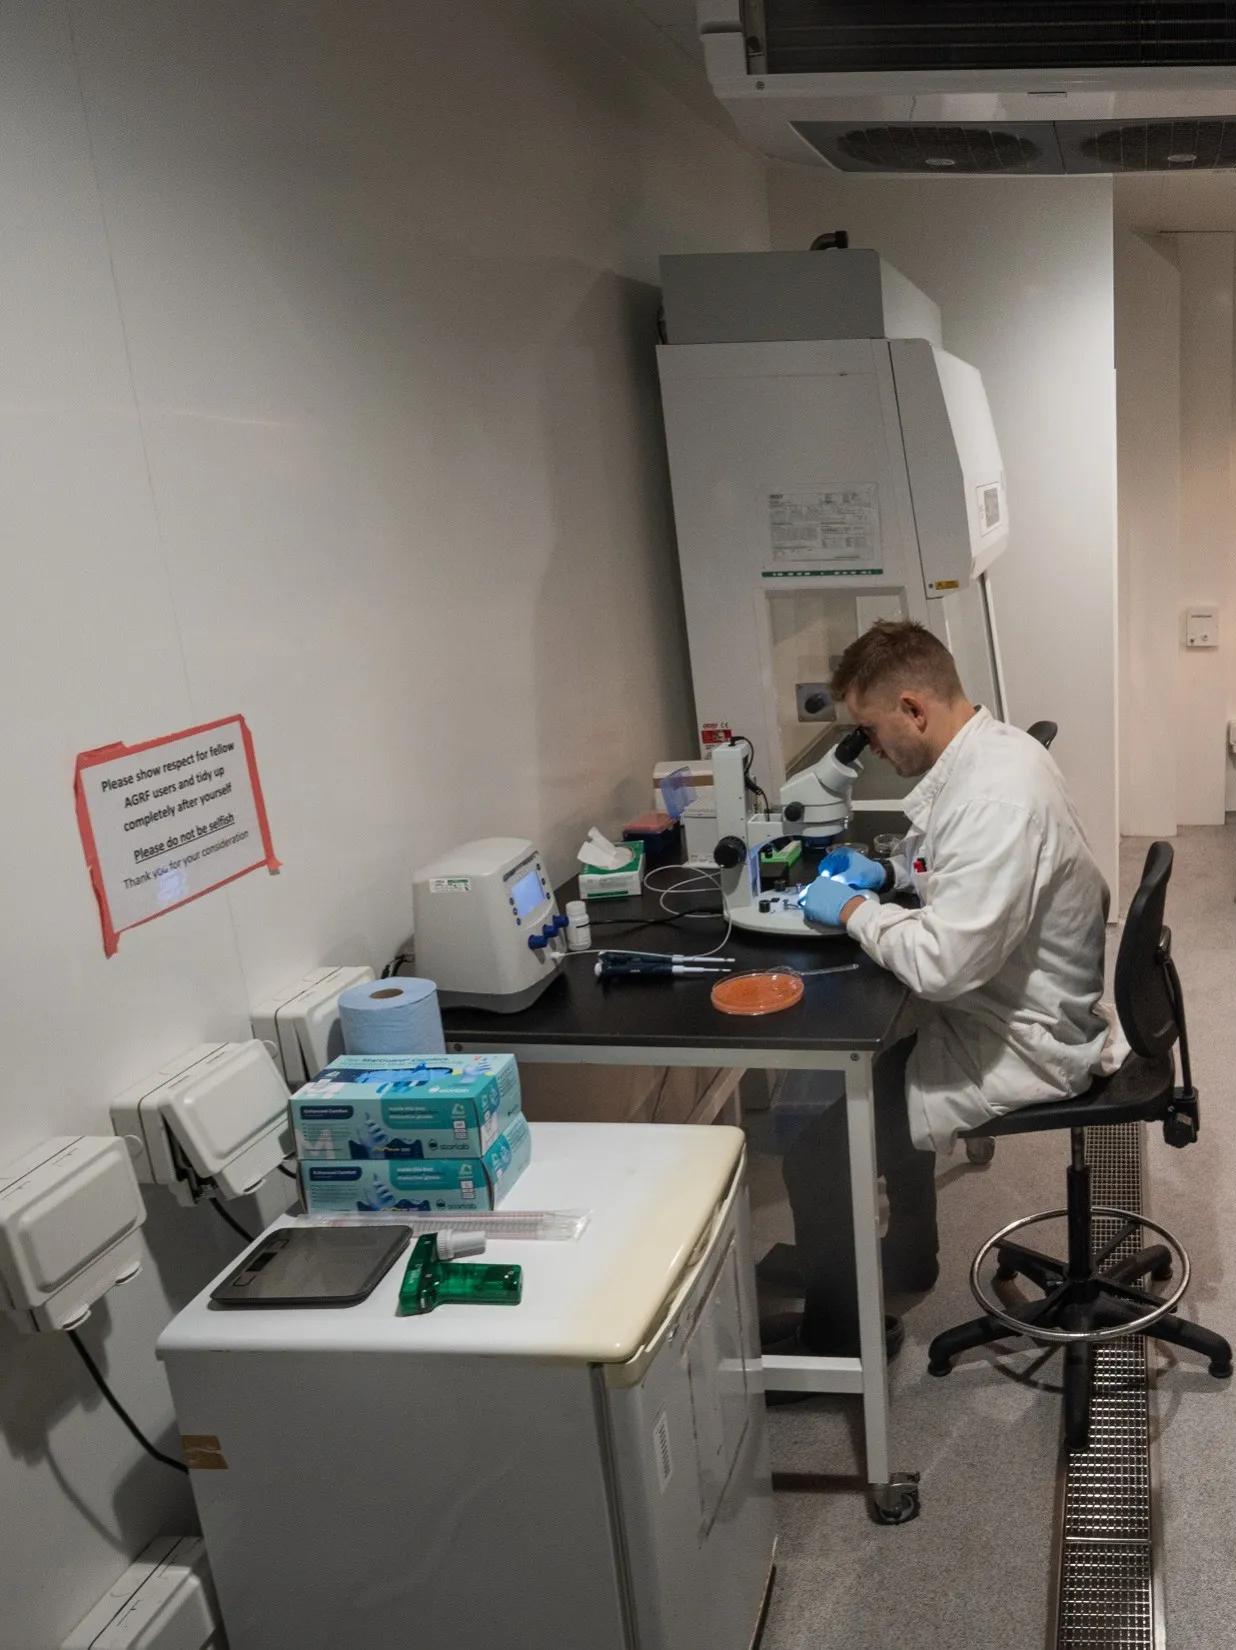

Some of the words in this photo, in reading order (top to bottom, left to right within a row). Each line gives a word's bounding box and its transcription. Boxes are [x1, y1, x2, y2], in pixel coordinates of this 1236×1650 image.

[101, 775, 134, 793] Please
[136, 766, 161, 782] show
[163, 755, 195, 773] respect
[196, 750, 208, 762] for
[209, 742, 235, 757] fellow
[124, 790, 151, 808] AGRF
[152, 783, 177, 799] users
[178, 774, 195, 790] and
[195, 769, 212, 784] tidy
[213, 766, 225, 779] up
[123, 804, 176, 832] completely
[177, 796, 198, 813] after
[199, 782, 232, 806] yourself
[123, 871, 151, 889] Thank
[152, 867, 169, 878] you
[168, 860, 181, 870] for
[182, 851, 201, 867] your
[201, 830, 249, 857] consideration
[134, 842, 165, 861] Please
[166, 835, 179, 848] do
[180, 829, 195, 843] not
[196, 825, 208, 836] be
[208, 813, 235, 831] selfish
